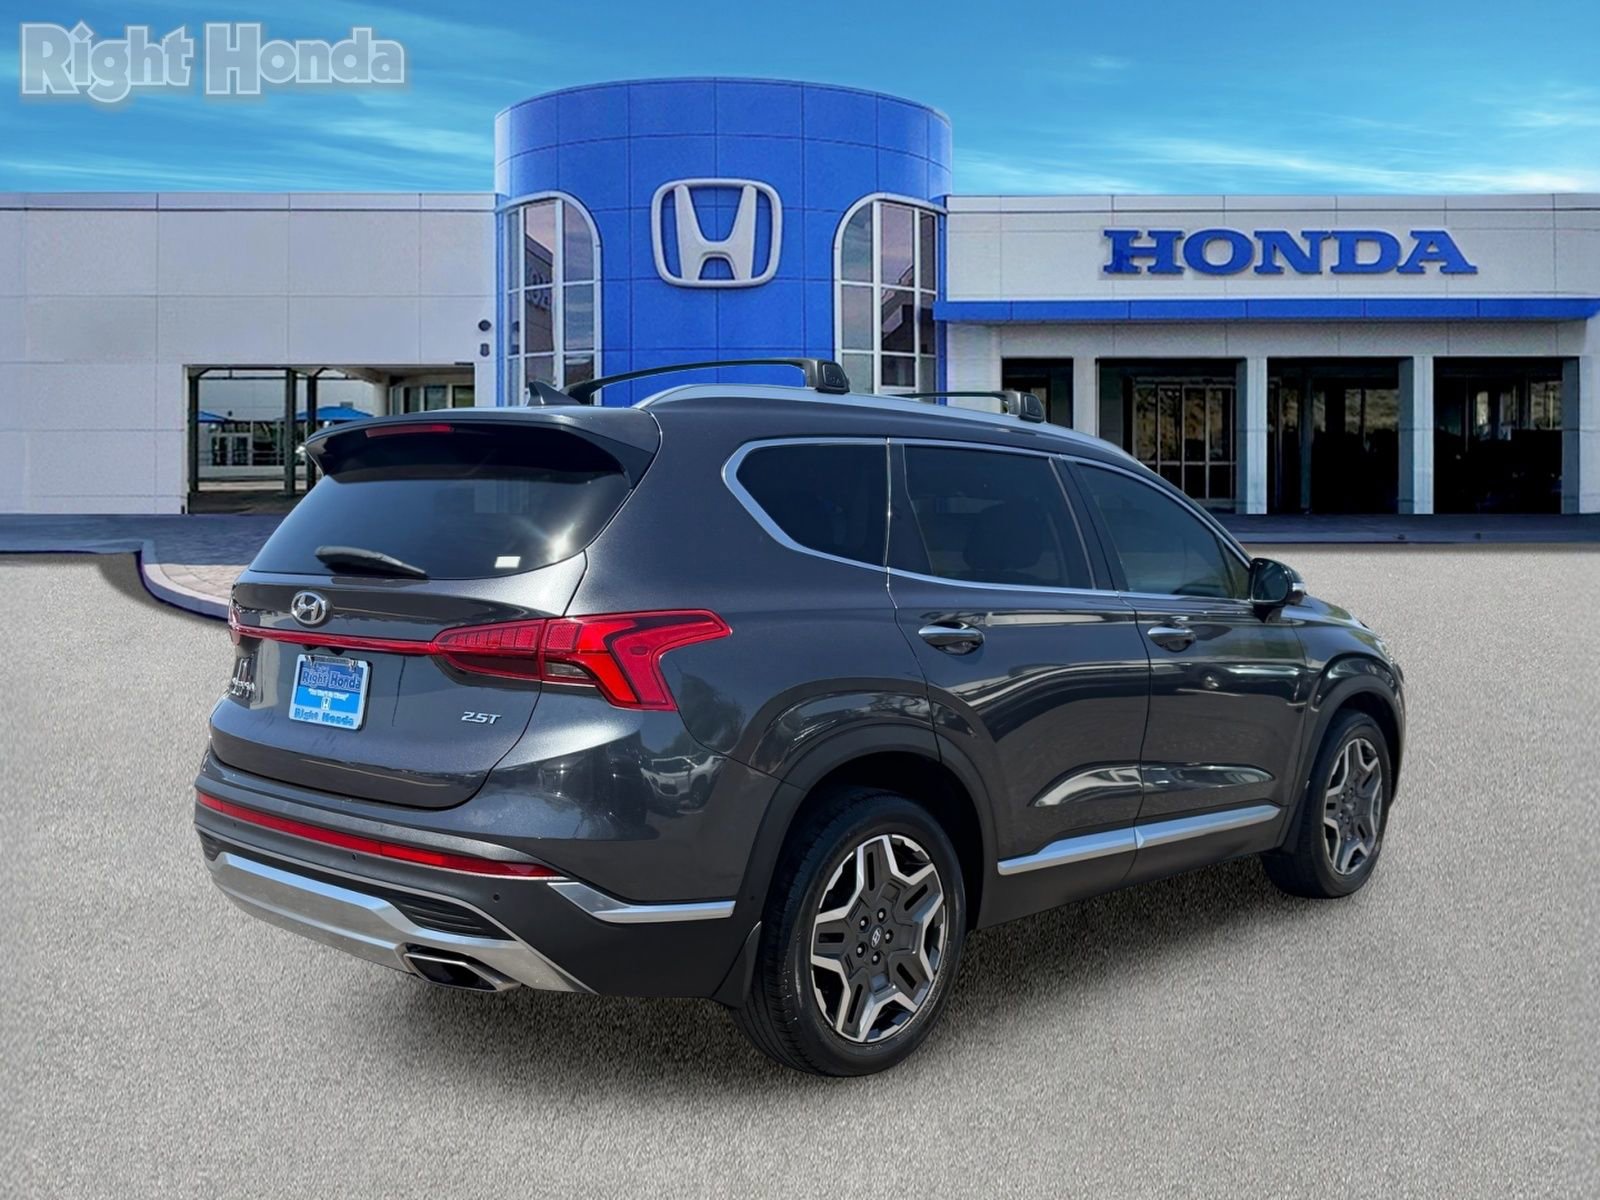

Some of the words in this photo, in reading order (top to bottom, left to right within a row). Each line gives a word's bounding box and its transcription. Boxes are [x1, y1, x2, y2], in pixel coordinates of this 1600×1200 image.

[1103, 228, 1479, 276] HONDA
[300, 666, 328, 688] Right
[329, 670, 361, 692] Honda
